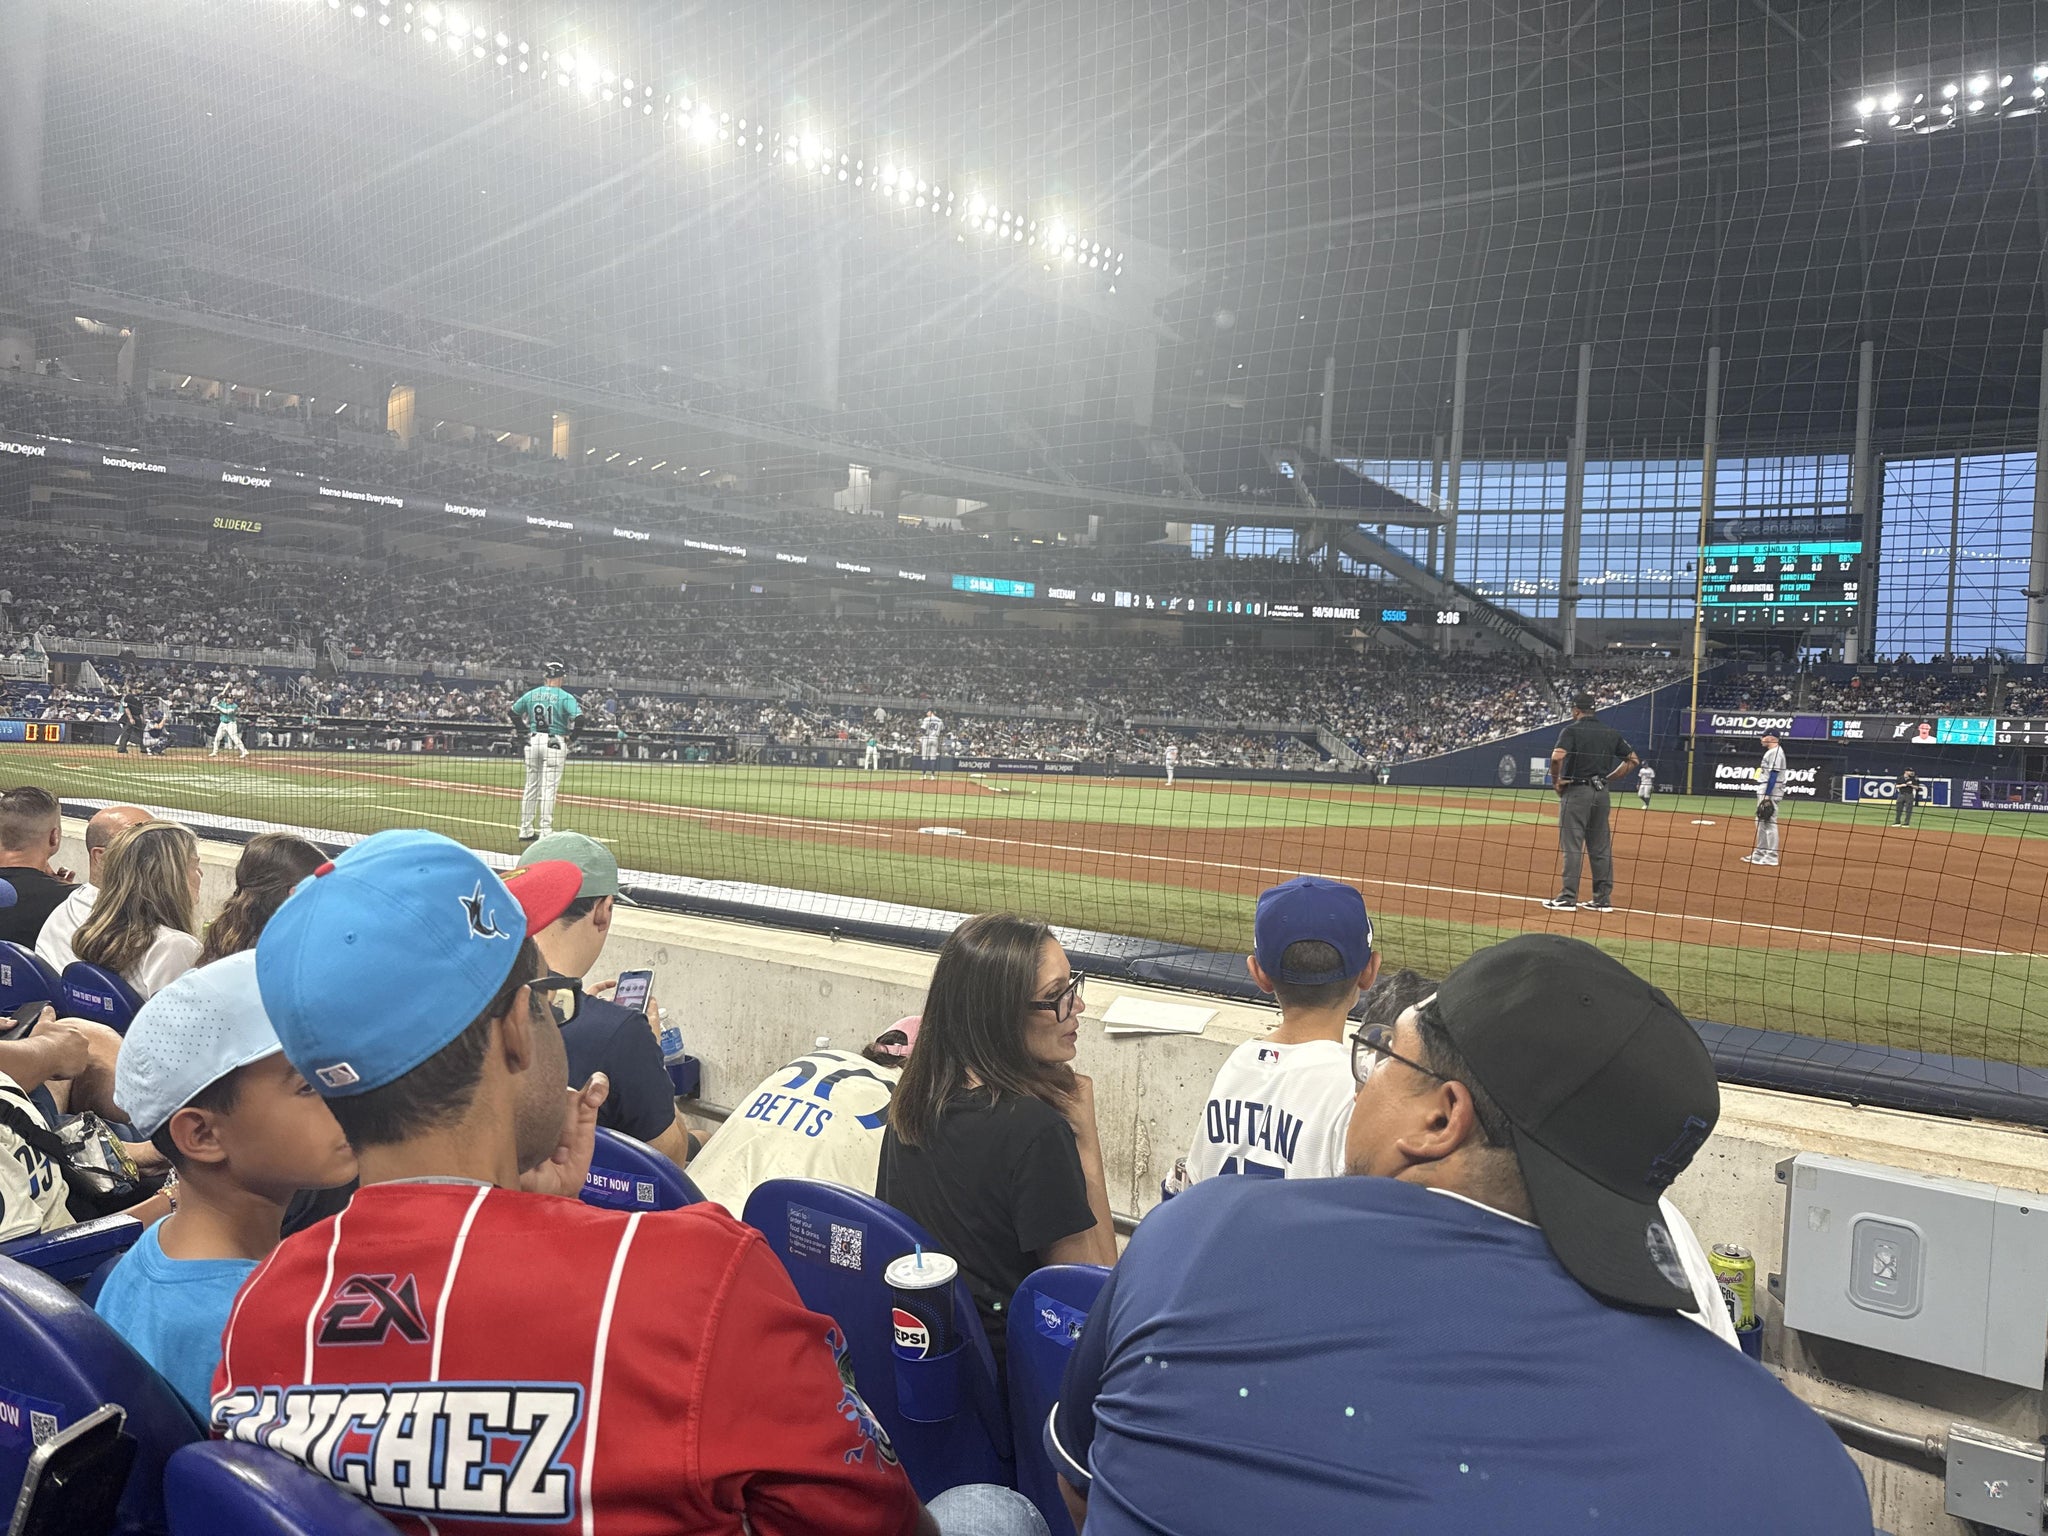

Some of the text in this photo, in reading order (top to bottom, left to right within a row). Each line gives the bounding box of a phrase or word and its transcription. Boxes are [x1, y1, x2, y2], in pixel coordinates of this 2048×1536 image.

[103, 455, 166, 473] loanDepot.com
[222, 472, 272, 488] loanDepot
[320, 487, 403, 508] Home Means Everything
[445, 503, 486, 518] loanDepot
[213, 517, 258, 532] SLIDERZ
[1334, 608, 1360, 620] RAFFLE
[1436, 611, 1460, 625] 3:06
[533, 703, 554, 728] 81
[1711, 714, 1793, 730] loanDepot
[1833, 720, 1844, 729] 39
[958, 759, 991, 769] loanDepot
[1044, 763, 1073, 772] loanDepot
[1715, 764, 1818, 784] loanpot
[1715, 782, 1739, 791] Home
[1864, 781, 1928, 799] GOA
[745, 1093, 833, 1137] BETTS
[1207, 1099, 1303, 1164] OHTANI
[586, 1173, 592, 1183] O
[593, 1175, 608, 1187] BET
[610, 1178, 630, 1192] NOW
[896, 1328, 926, 1345] EPSI
[0, 1402, 19, 1427] OW
